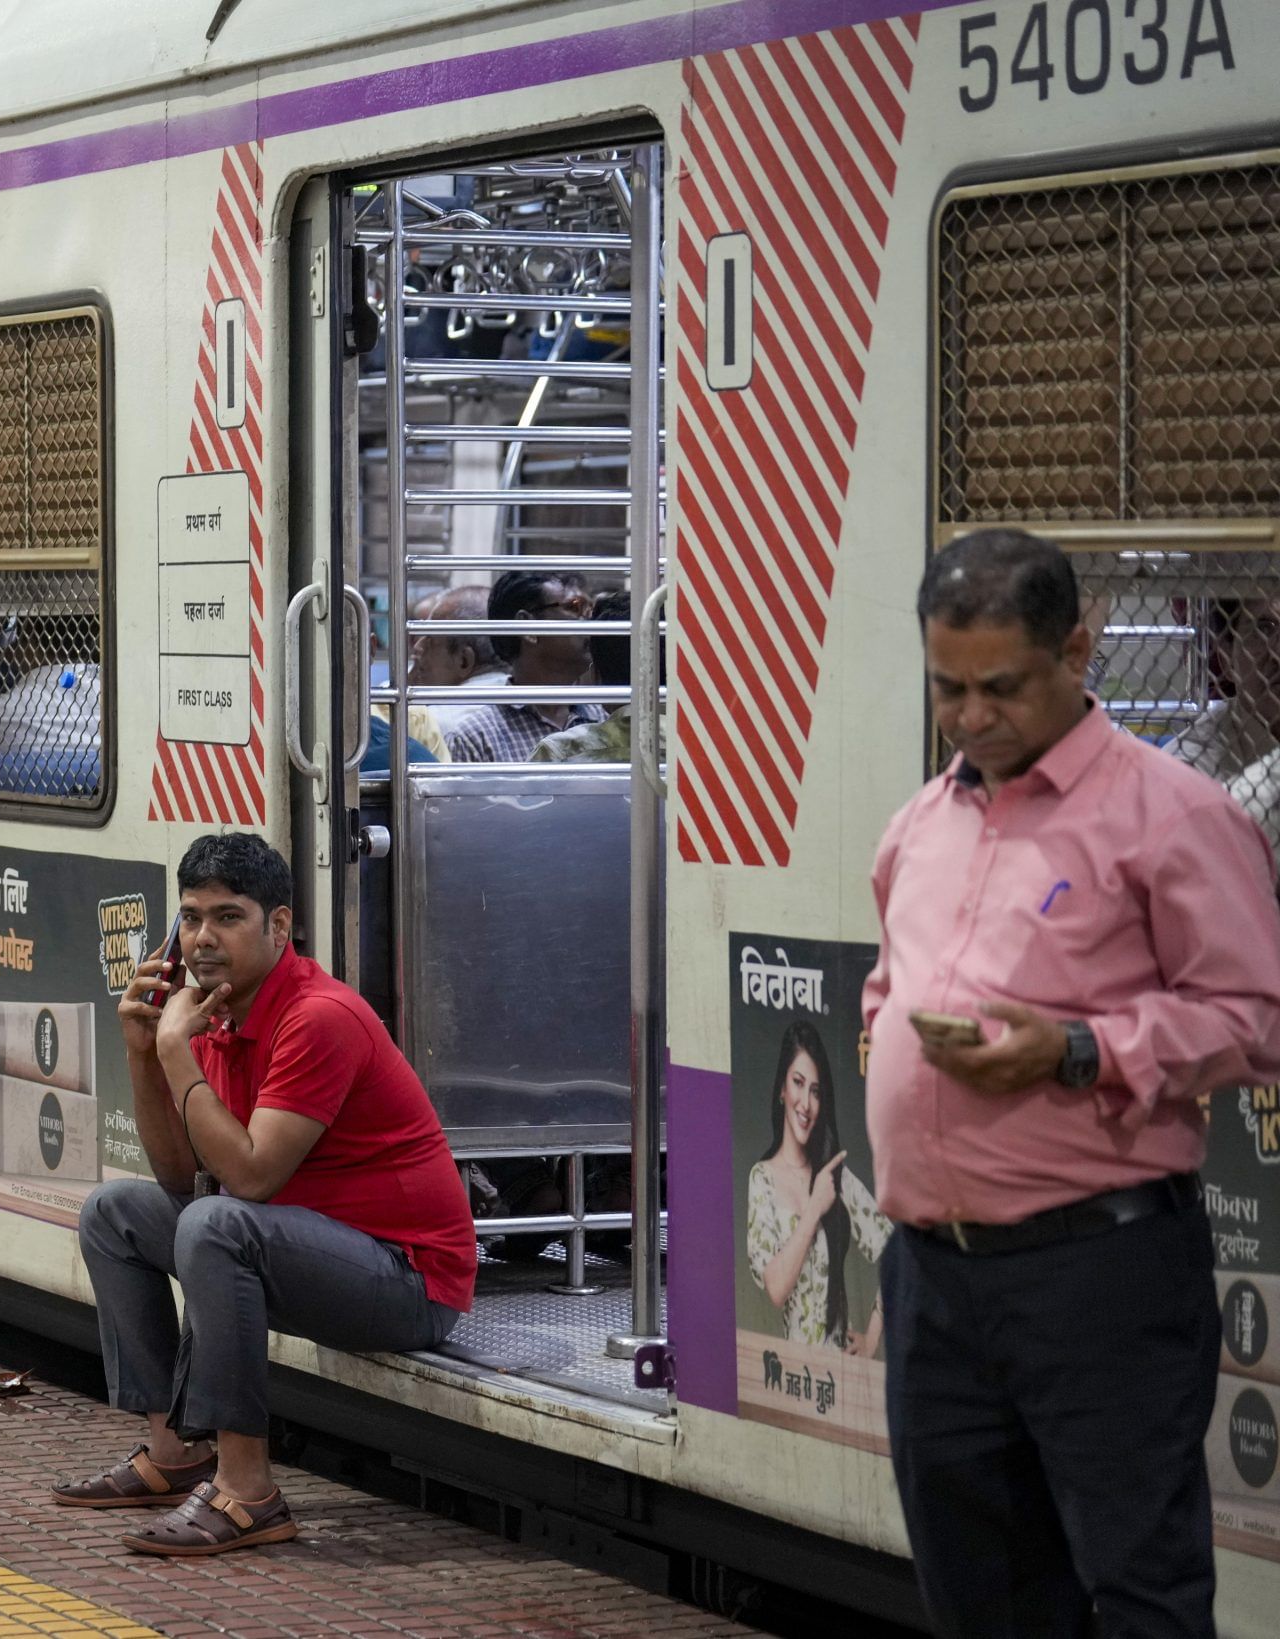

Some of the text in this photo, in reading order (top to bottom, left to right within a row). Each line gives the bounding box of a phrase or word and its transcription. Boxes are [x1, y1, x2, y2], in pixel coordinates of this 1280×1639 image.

[958, 0, 1236, 113] 5403A
[186, 506, 221, 532] प्रथम वर्ग
[184, 596, 225, 622] पहला दर्जा
[178, 689, 232, 707] FIRST CLASS
[3, 868, 28, 914] लिए
[101, 902, 145, 932] VITHOBA
[105, 933, 129, 960] KIYA
[740, 945, 823, 1013] विठोबा
[785, 1371, 801, 1401] जड़
[803, 1365, 811, 1400] से
[1232, 1415, 1276, 1440] VITHOBA
